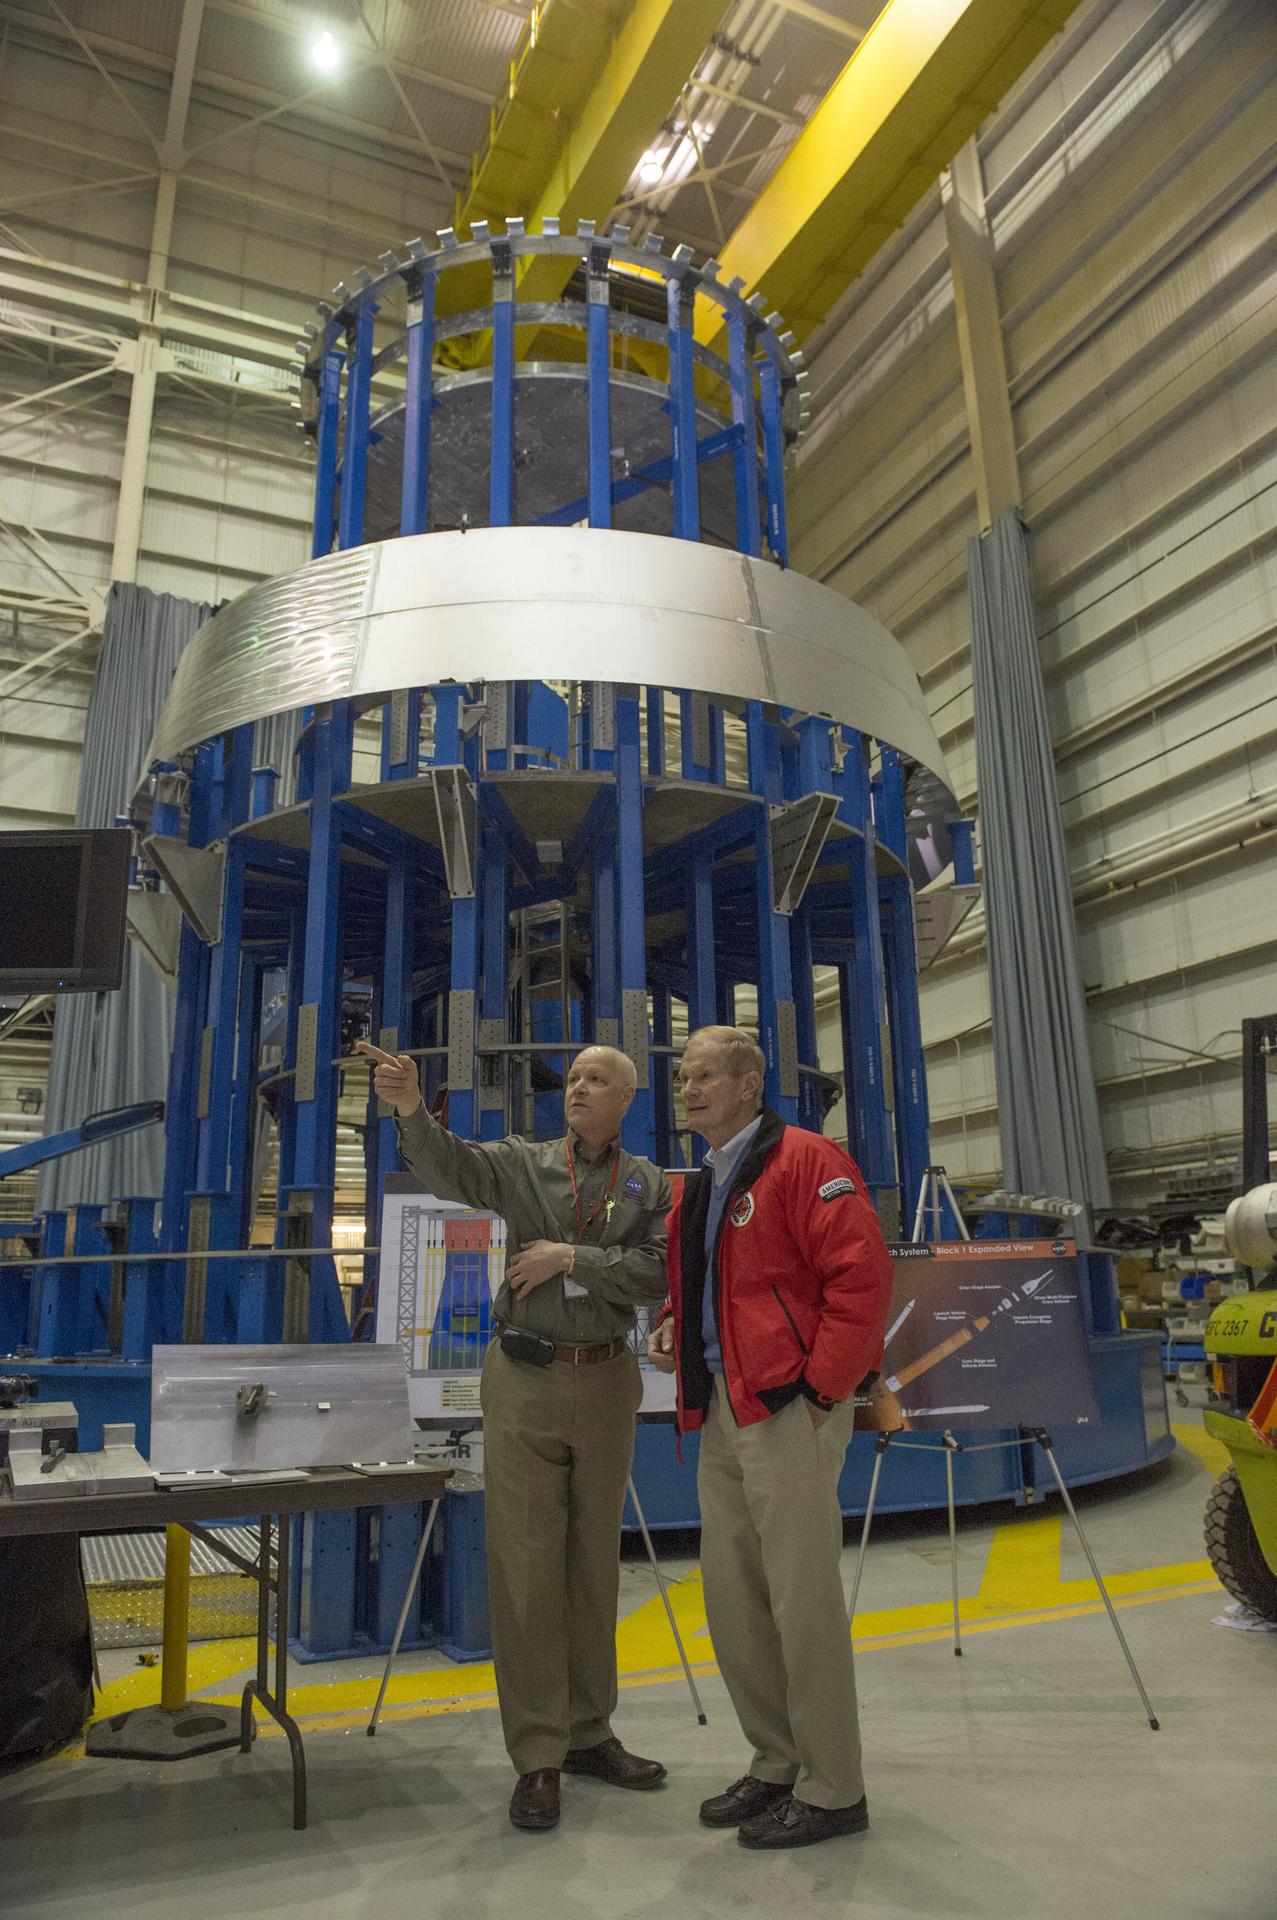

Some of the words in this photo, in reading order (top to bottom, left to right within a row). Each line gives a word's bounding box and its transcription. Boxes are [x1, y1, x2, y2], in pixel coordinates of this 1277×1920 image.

[900, 1248, 929, 1258] System
[936, 1246, 959, 1255] Block
[968, 1244, 1012, 1254] Expanded
[1013, 1244, 1034, 1252] View
[1222, 1319, 1249, 1336] 2367
